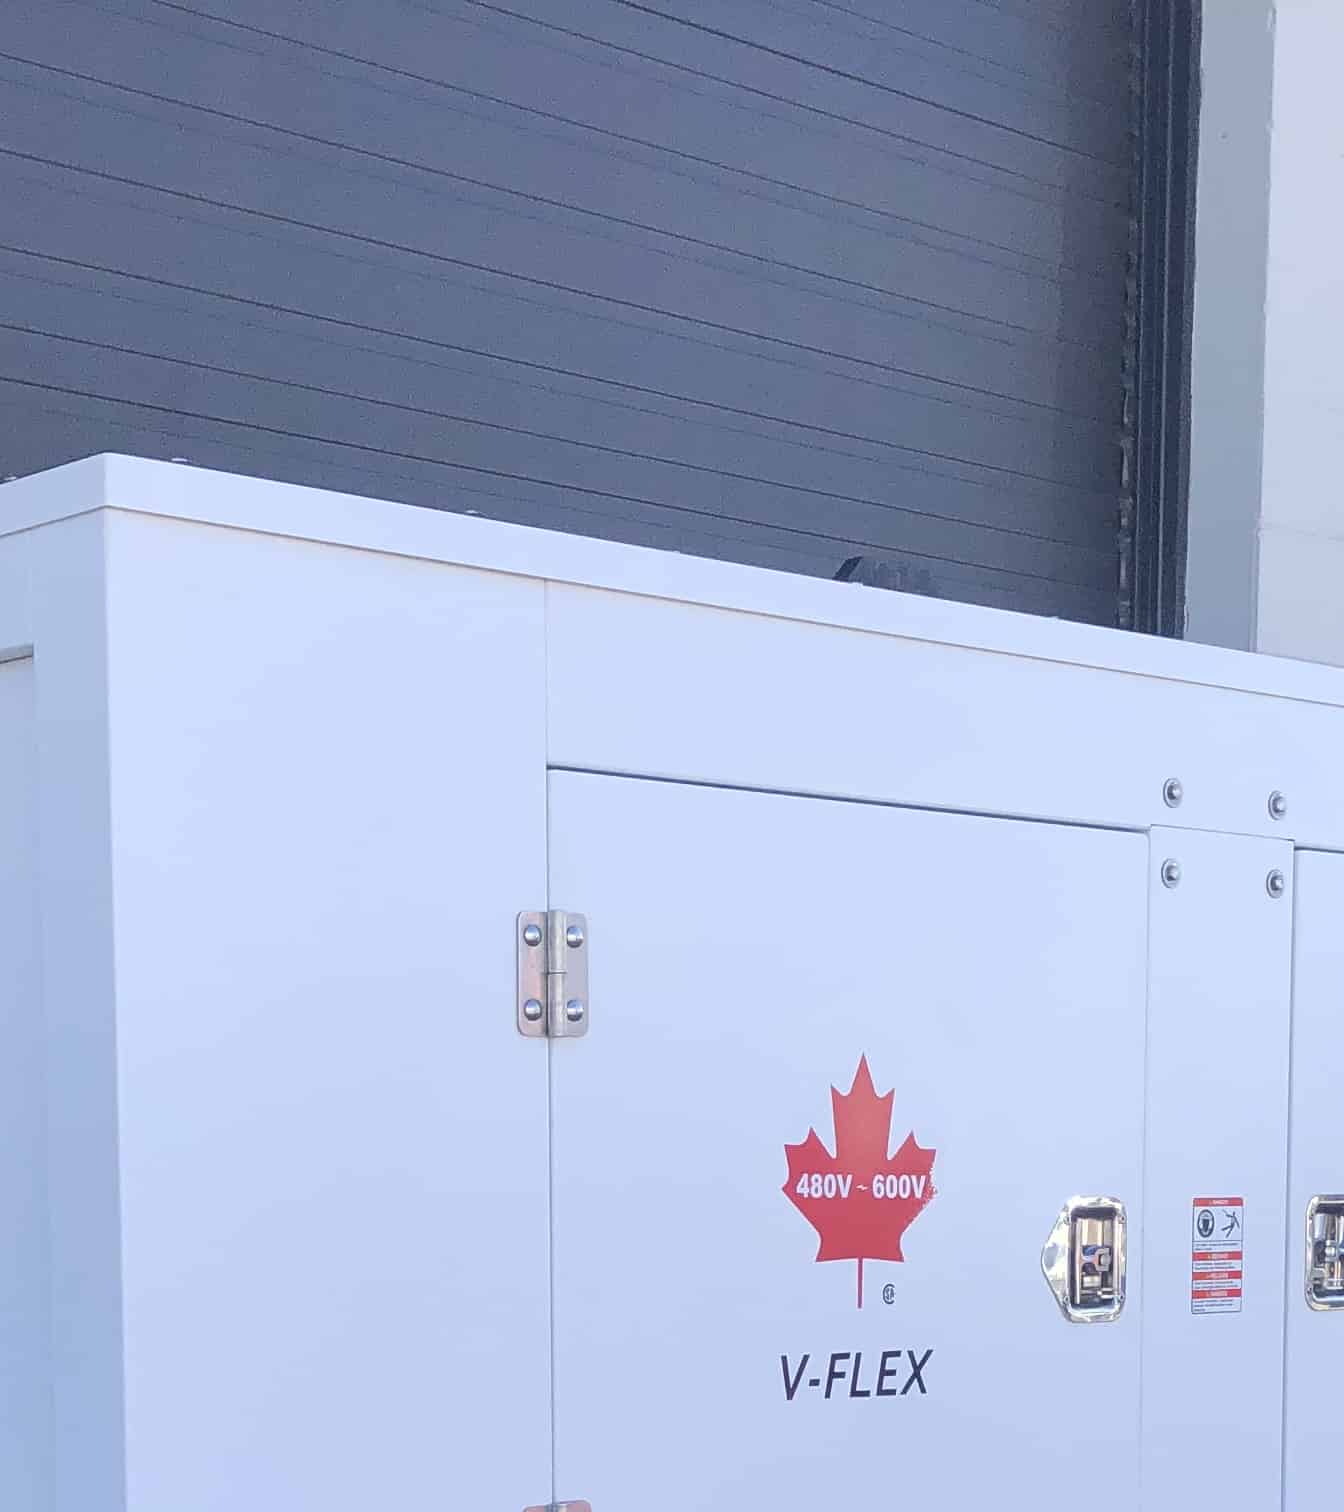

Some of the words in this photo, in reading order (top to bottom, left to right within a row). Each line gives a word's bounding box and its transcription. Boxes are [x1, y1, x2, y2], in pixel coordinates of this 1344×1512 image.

[796, 1172, 854, 1199] 480V
[871, 1173, 927, 1200] 600V
[780, 1349, 934, 1401] V-FLEX
